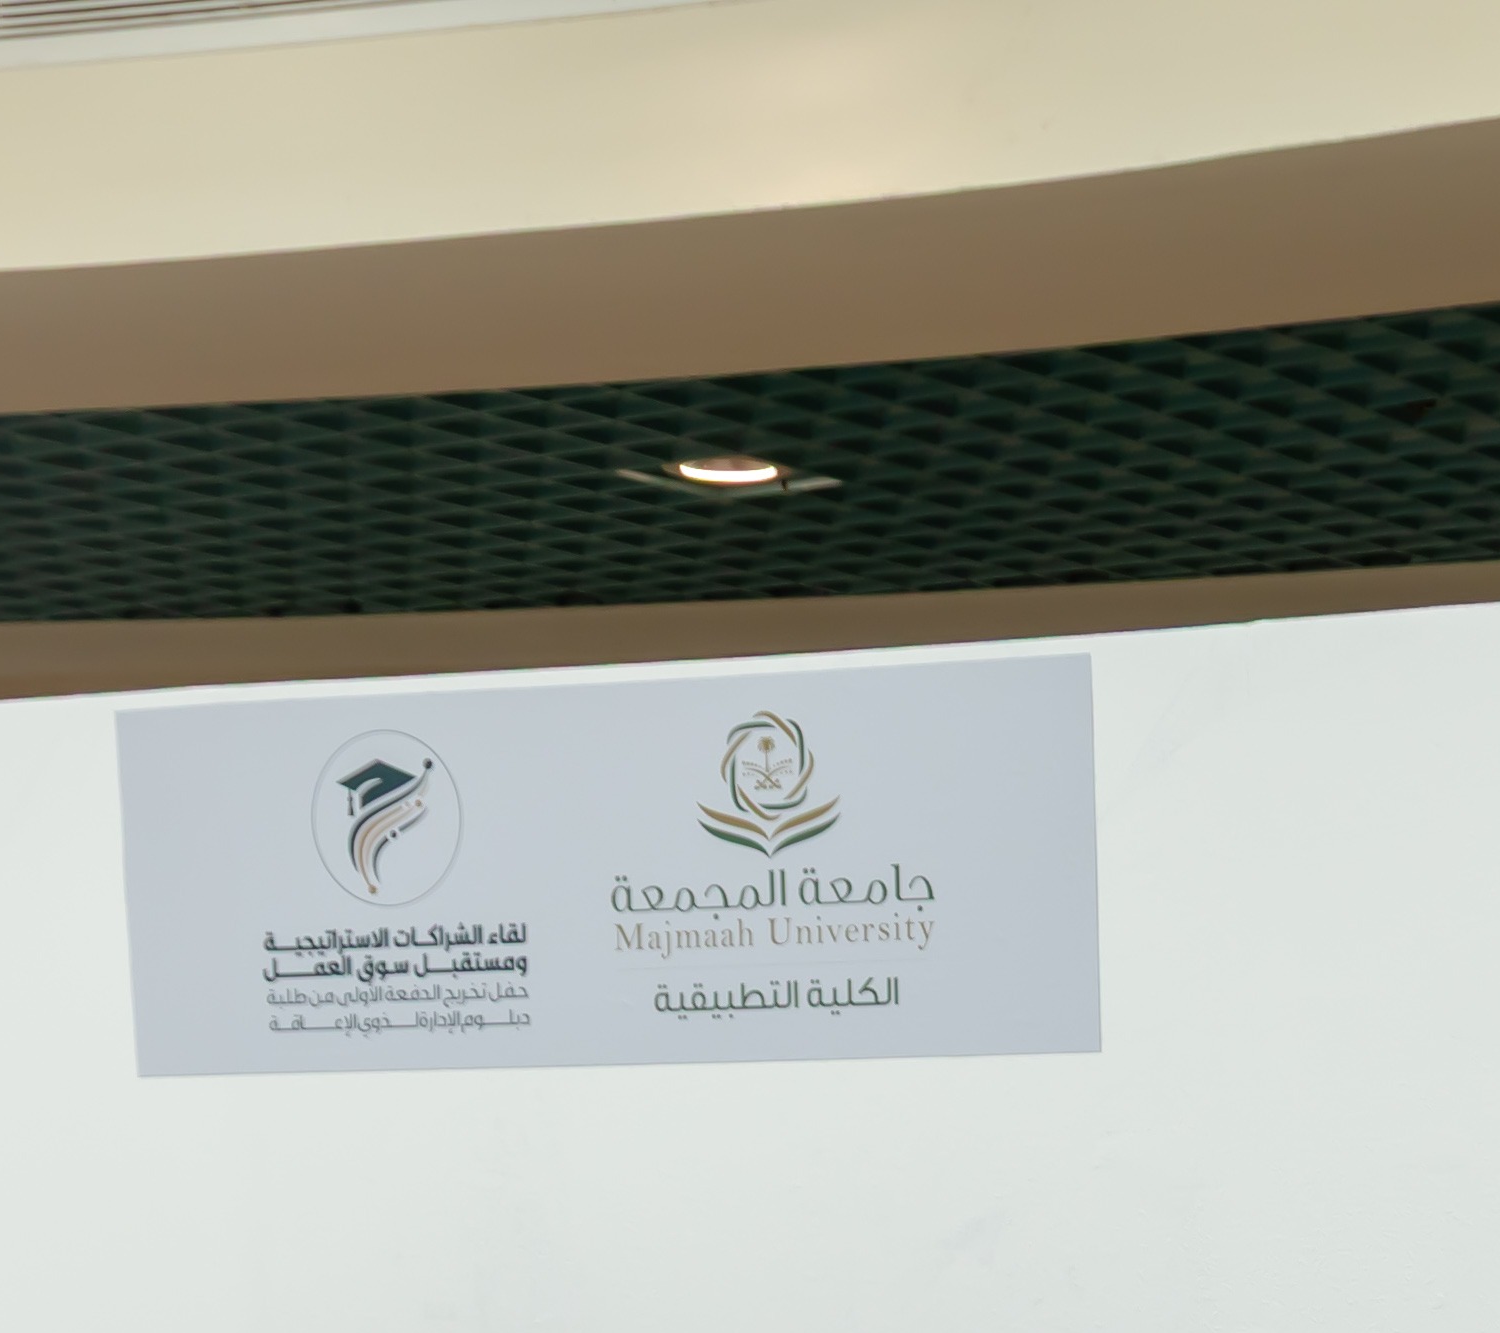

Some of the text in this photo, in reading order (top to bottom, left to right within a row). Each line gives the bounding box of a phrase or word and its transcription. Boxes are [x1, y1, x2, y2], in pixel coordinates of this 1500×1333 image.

[611, 863, 936, 921] جامعة المجمعة
[263, 921, 527, 957] لقاء الشراكات الاستراتيجية
[614, 912, 935, 959] Majmaah University
[262, 952, 527, 983] ومستقبل سوق العمل
[654, 975, 900, 1020] الكلية التطبيقية
